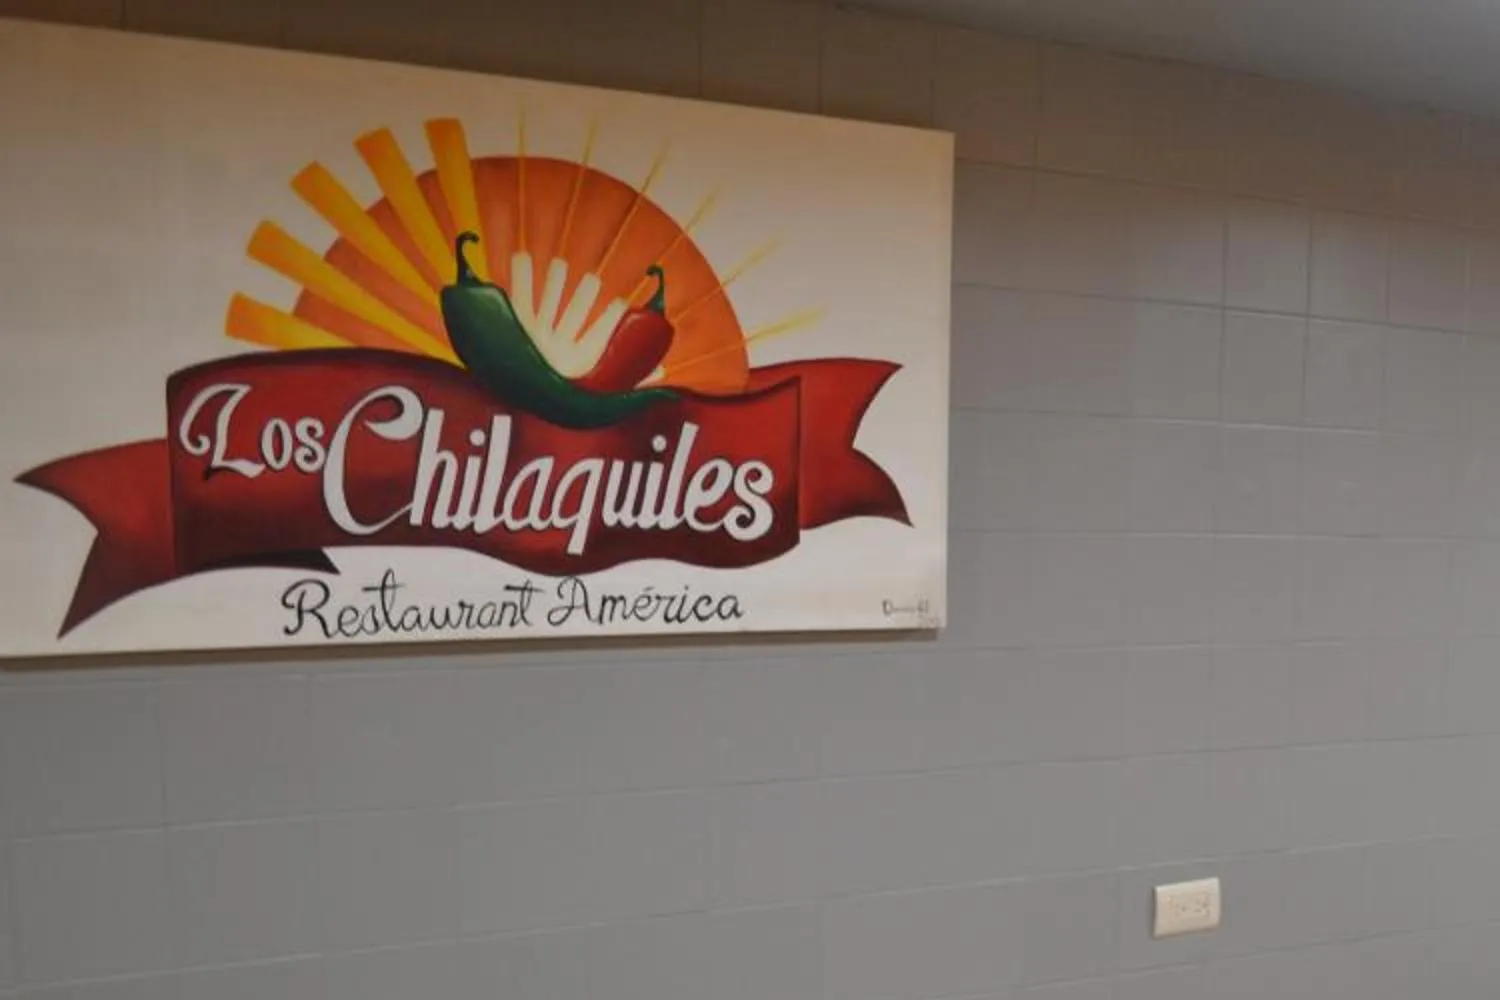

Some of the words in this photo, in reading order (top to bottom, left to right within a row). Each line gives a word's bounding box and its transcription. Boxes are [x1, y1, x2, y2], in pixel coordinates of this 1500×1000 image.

[180, 383, 325, 478] Los
[323, 385, 774, 557] Chilaquiles
[281, 568, 545, 640] Restaurant
[547, 576, 744, 628] América
